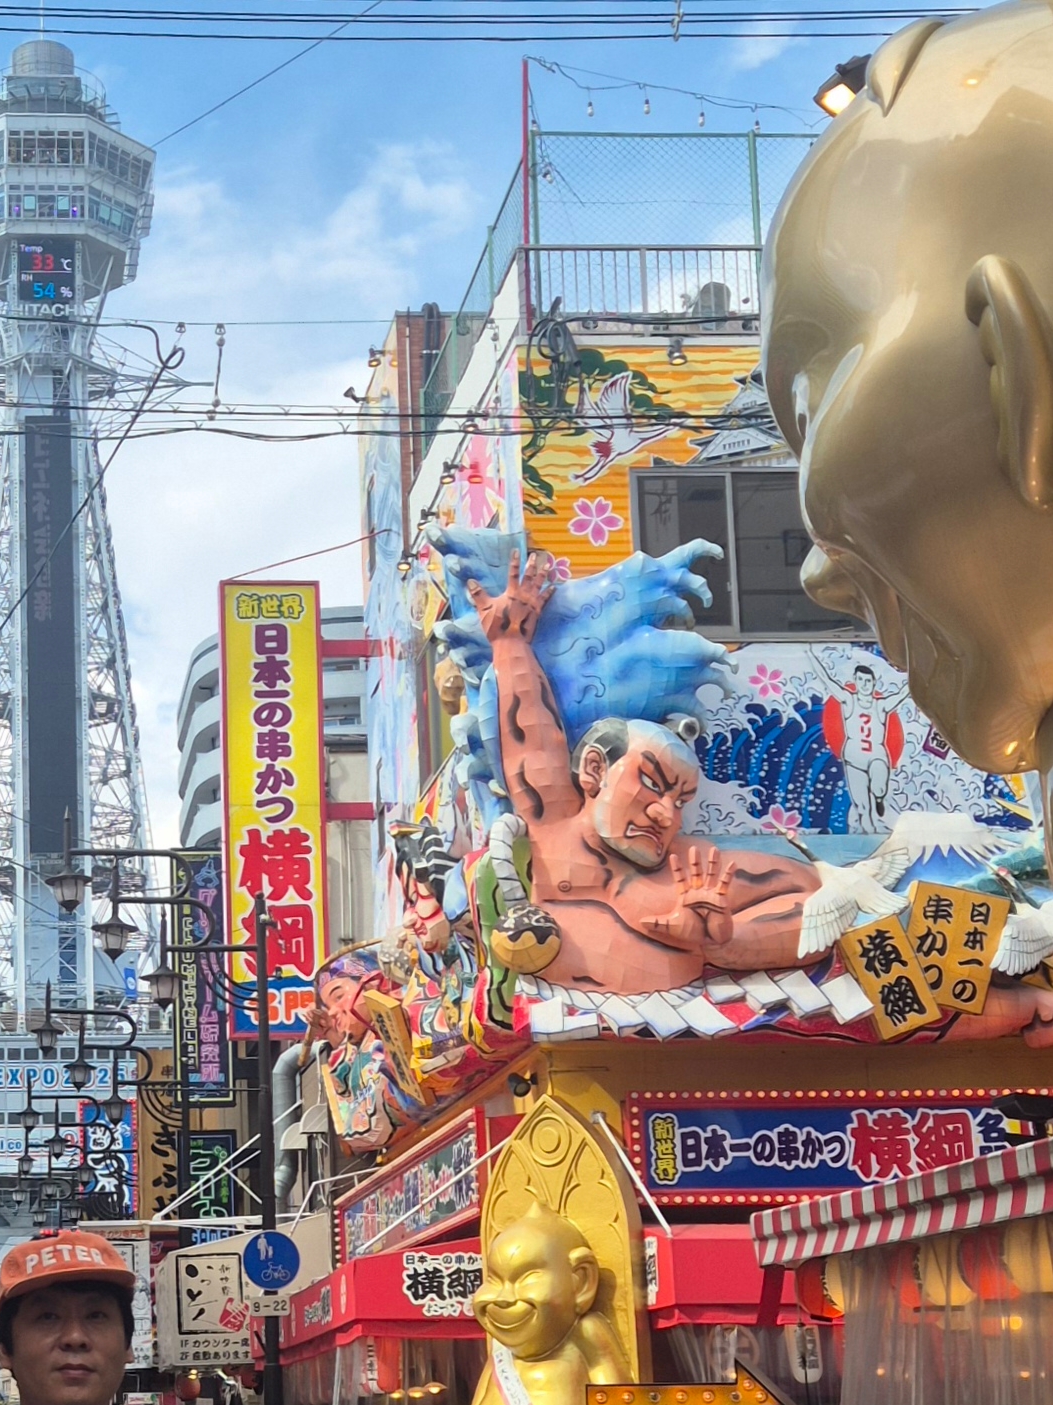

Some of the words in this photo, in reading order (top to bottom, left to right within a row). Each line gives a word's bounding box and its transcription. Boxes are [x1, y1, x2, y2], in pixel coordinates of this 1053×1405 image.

[20, 244, 43, 253] Temp
[32, 254, 54, 271] 33
[21, 274, 33, 282] RH
[33, 282, 55, 299] 54
[60, 286, 72, 298] %
[236, 593, 305, 620] 新世界
[252, 623, 295, 824] 日本一の串かつ
[238, 827, 316, 979] 横綱
[916, 893, 954, 991] 串かつ
[952, 901, 991, 1004] 日本一の
[650, 1115, 679, 1183] 新世界
[680, 1127, 845, 1168] 日本一の串かつ
[850, 1110, 975, 1179] 横綱
[25, 1244, 106, 1274] PETER
[405, 1254, 482, 1266] 日本一の串か
[253, 1299, 288, 1313] 9-22
